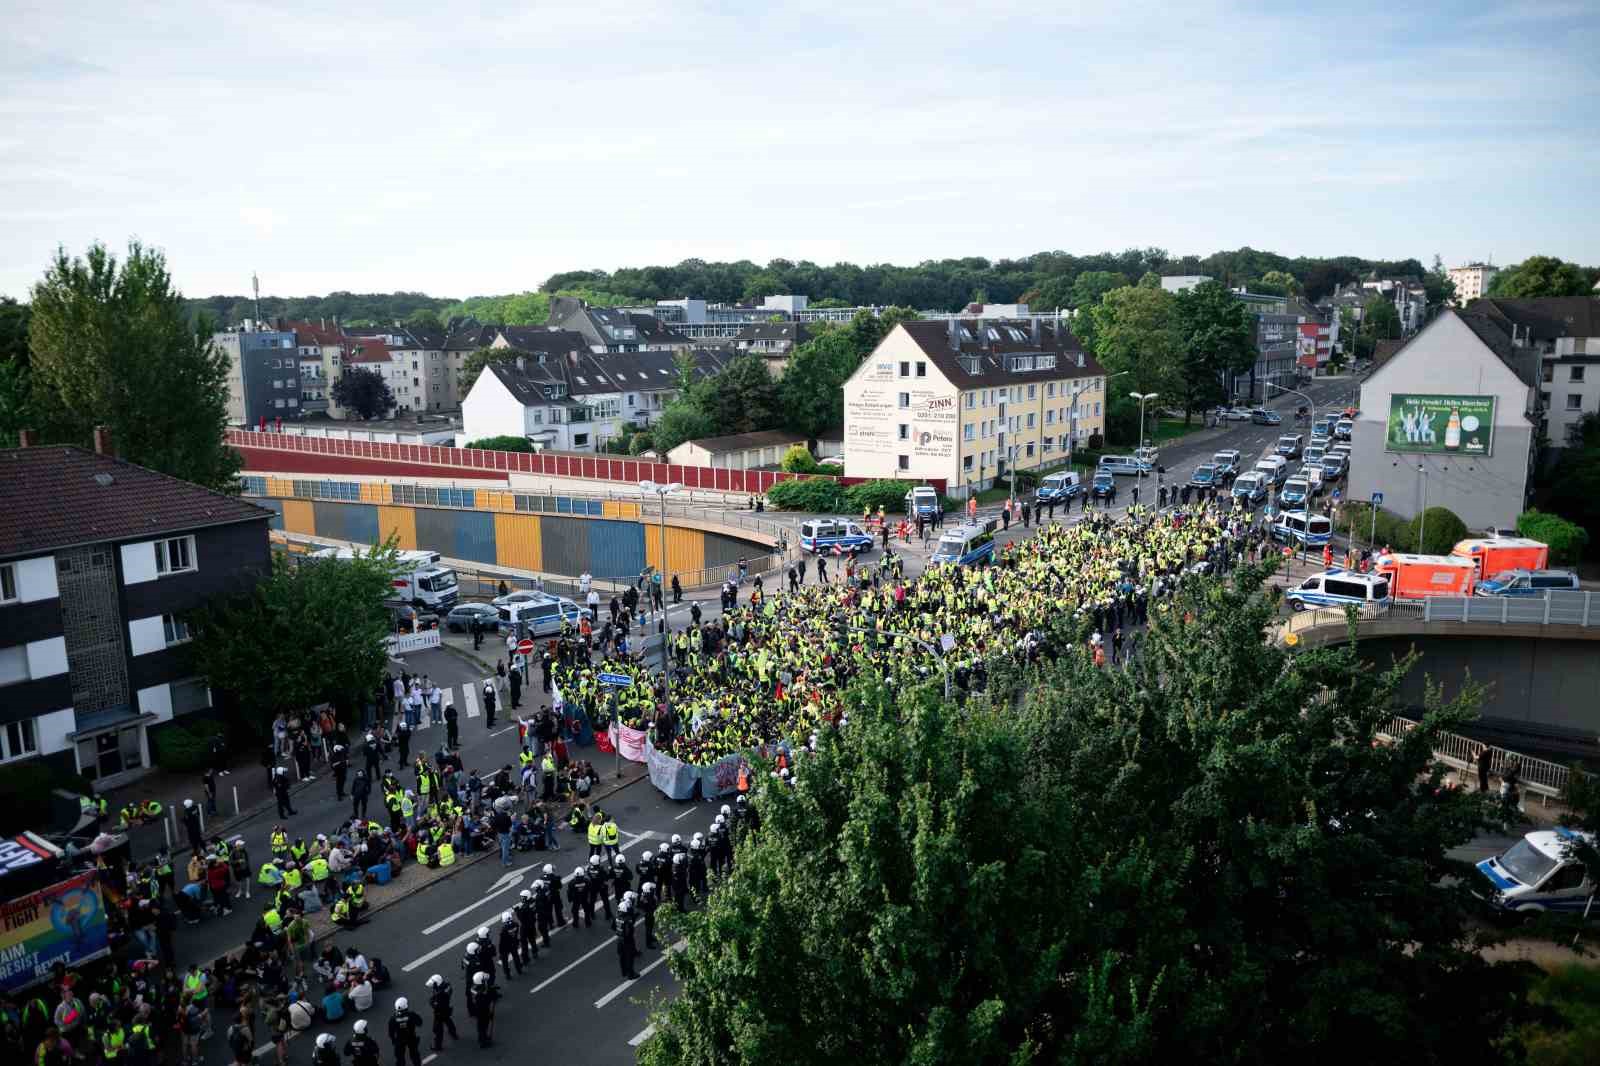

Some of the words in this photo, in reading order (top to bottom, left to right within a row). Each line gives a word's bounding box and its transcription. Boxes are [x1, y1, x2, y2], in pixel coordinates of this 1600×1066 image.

[929, 398, 952, 409] ZINN
[4, 905, 39, 931] FIGHT
[0, 951, 40, 980] RESIST
